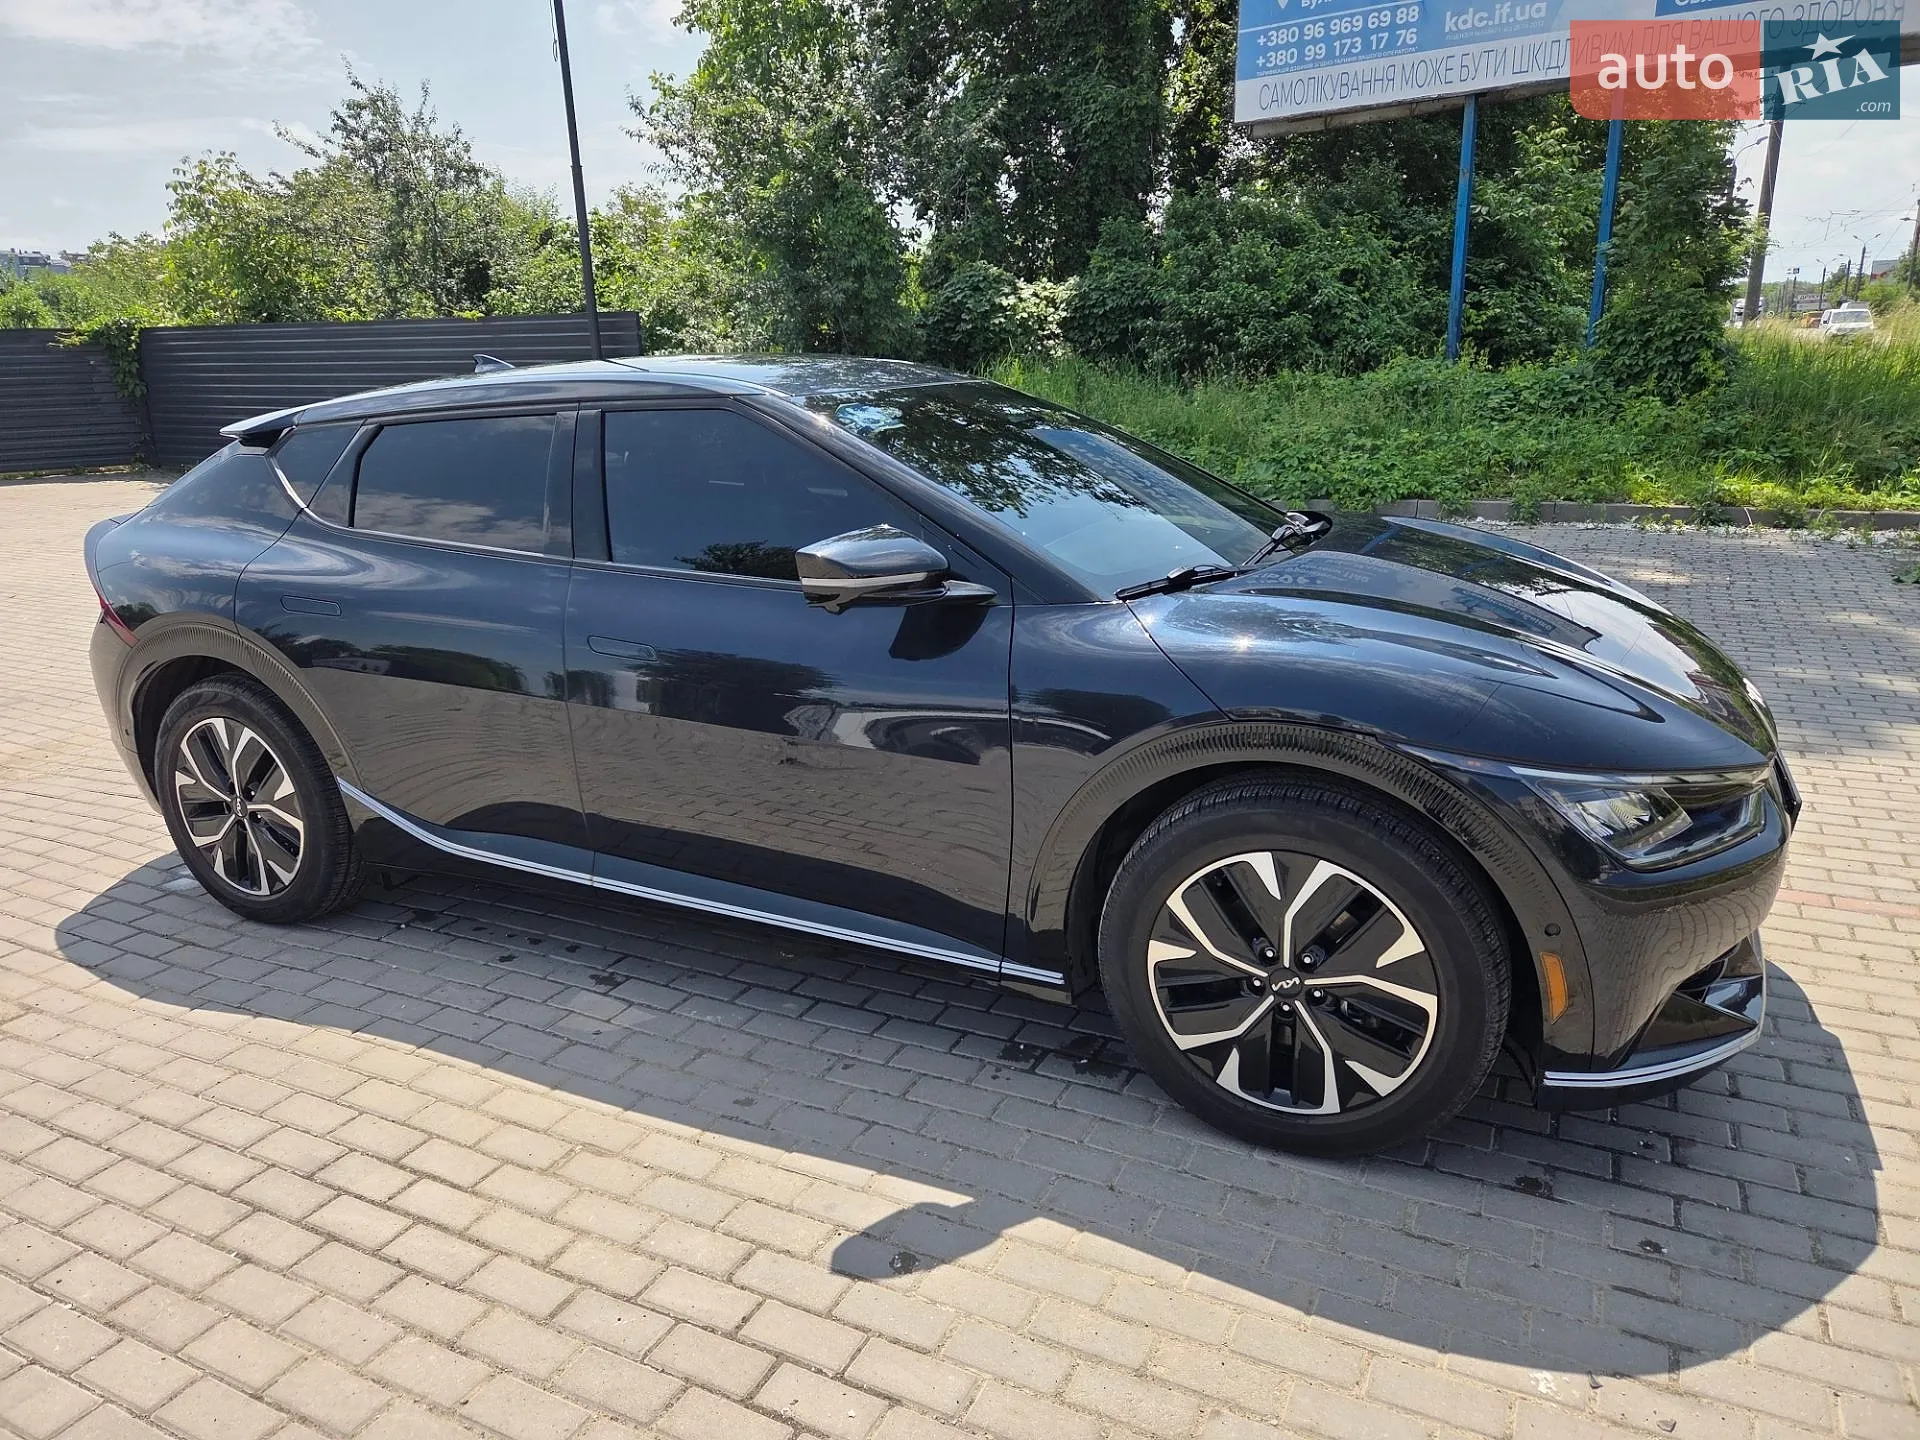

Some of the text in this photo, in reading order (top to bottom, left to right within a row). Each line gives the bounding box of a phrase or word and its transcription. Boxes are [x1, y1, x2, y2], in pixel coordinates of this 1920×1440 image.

[1257, 5, 1419, 47] +380 96 969 69 88
[1445, 1, 1548, 33] kdc.if.ua
[1256, 48, 1298, 68] +380
[1304, 43, 1326, 62] 99
[1333, 37, 1362, 57] 173
[1370, 32, 1389, 50] 17
[1395, 28, 1418, 47] 76
[1258, 64, 1396, 111] САМОЛІКУВАННЯ
[1401, 55, 1455, 91] МОЖЕ
[1459, 47, 1507, 82] БУТИ
[1511, 29, 1636, 76] ШКІДЛИВИМ
[1640, 22, 1684, 57] ДЛЯ
[1690, 7, 1785, 51] ВАШОГО
